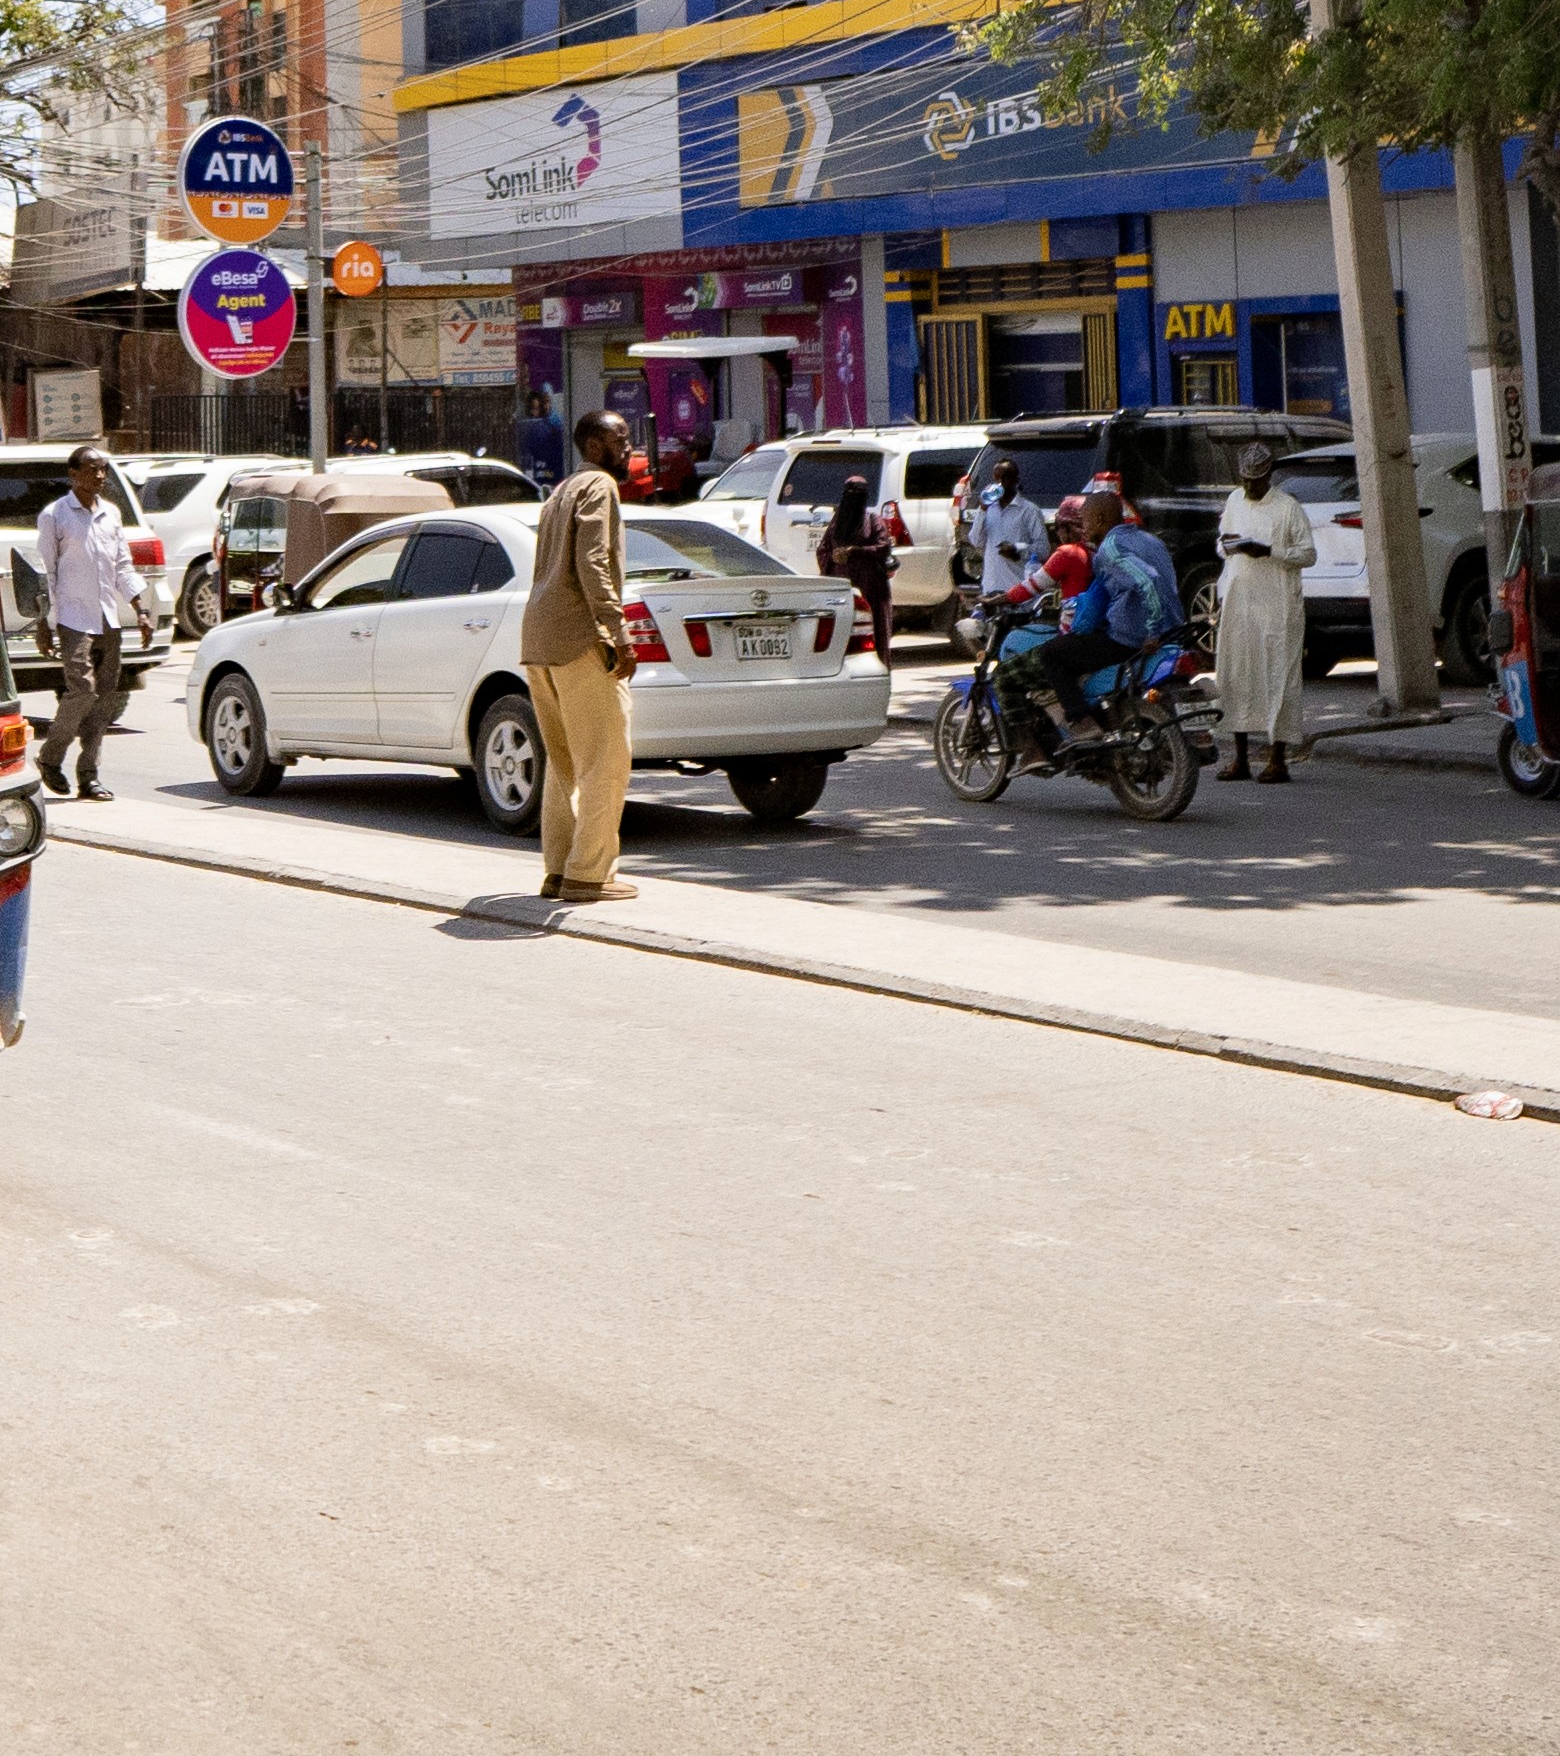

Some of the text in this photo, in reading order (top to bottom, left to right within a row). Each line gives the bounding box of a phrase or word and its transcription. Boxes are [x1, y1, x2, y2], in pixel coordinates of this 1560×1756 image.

[203, 151, 279, 184] ATM
[484, 155, 577, 201] SomLink
[247, 206, 266, 215] VISA
[210, 270, 259, 286] eBesa
[341, 253, 375, 279] ria
[216, 293, 267, 311] Agent
[1164, 302, 1236, 340] ATM
